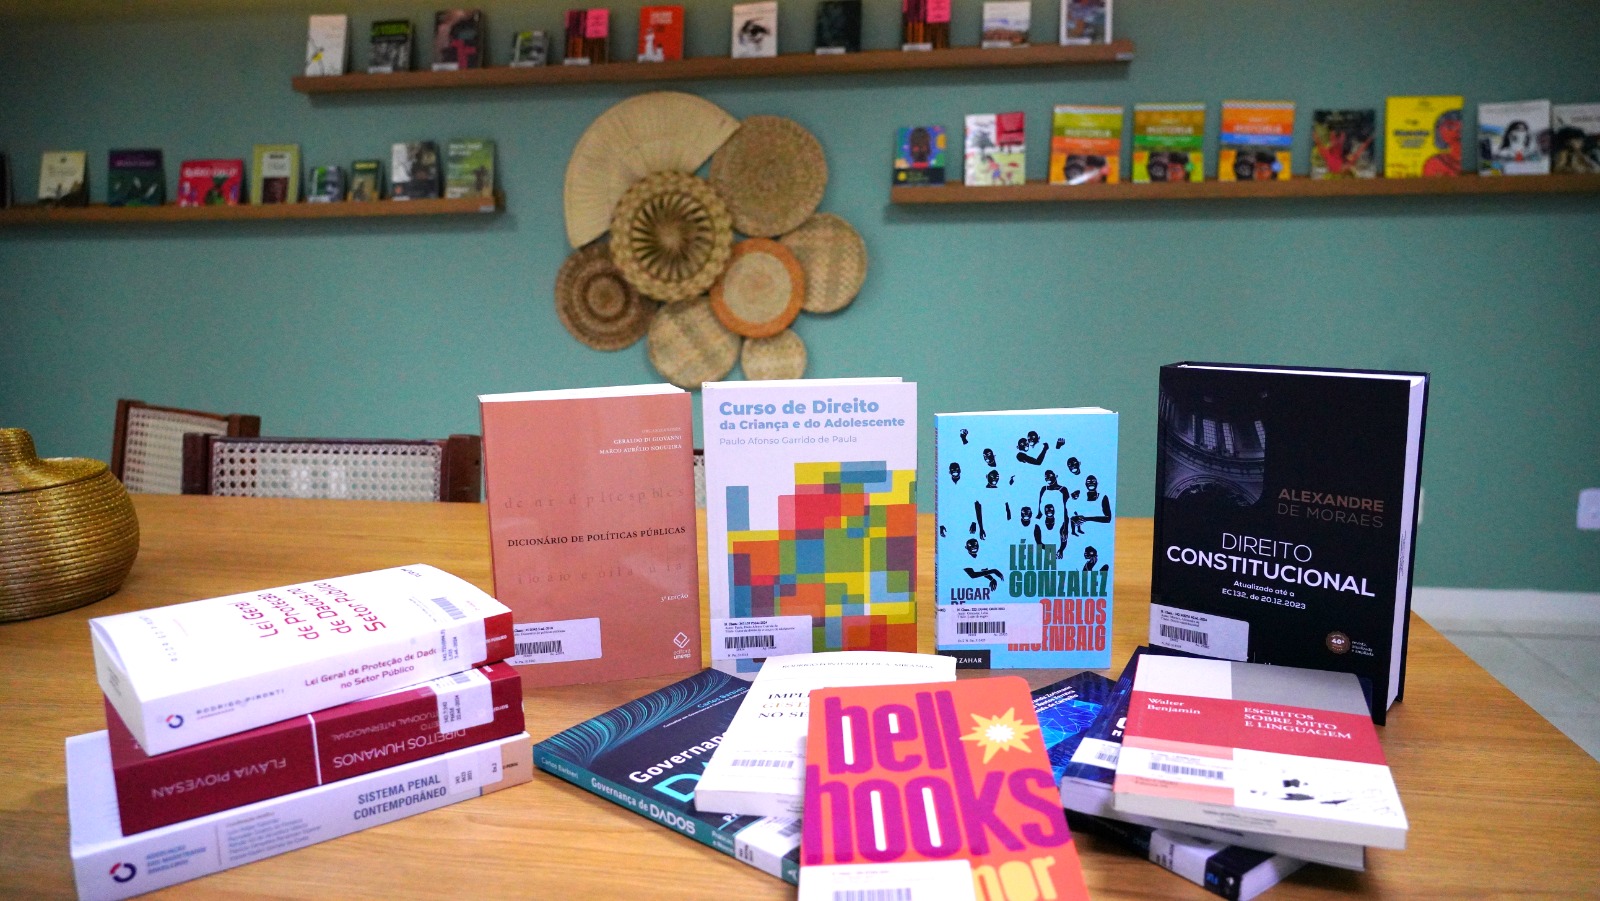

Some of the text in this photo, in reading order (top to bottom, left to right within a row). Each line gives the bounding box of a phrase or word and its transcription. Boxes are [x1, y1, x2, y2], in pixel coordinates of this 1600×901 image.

[719, 397, 880, 416] Curso de Direito
[719, 417, 905, 432] da Criança e do Adolescente
[623, 445, 651, 453] AURÉLIO
[719, 434, 858, 446] Paulo Afonso Garrido de Paula
[1278, 488, 1385, 512] ALEXANDRE
[1277, 503, 1384, 528] DE MORAES
[507, 526, 686, 547] DICIONÁRIO DE POLÍTICAS PÚBLICAS
[1221, 532, 1313, 563] DIREITO
[1009, 538, 1057, 571] LÉLIA
[1008, 570, 1109, 598] GONZALEZ
[1166, 545, 1376, 598] CONSTITUCIONAL
[950, 587, 990, 601] LUGAR
[1221, 588, 1233, 596] EC
[1249, 592, 1260, 601] de
[1260, 595, 1307, 610] 20.12.2023
[1233, 580, 1274, 594] Atualizado
[1274, 587, 1289, 596] até
[226, 600, 279, 638] Lei Geral
[257, 592, 320, 640] de Proteção
[298, 594, 339, 619] Dados
[348, 603, 387, 632] Setor
[1039, 598, 1107, 625] CARLOS
[329, 619, 352, 634] de
[304, 675, 319, 687] Lei
[320, 670, 347, 683] Geral
[348, 667, 360, 676] de
[361, 656, 403, 673] Proteção
[404, 653, 415, 662] de
[340, 664, 415, 689] no Setor Público
[196, 699, 242, 715] RODRIGO
[245, 688, 285, 703] PIRONTI
[696, 694, 719, 709] Carlos
[719, 685, 747, 699] Barbieri
[1146, 704, 1201, 715] Benjamin
[1147, 697, 1185, 707] Walter
[1243, 706, 1315, 720] ESCRITOS
[1243, 714, 1338, 731] SOBRE MITO
[330, 722, 397, 741] INTERNACIONAL
[824, 690, 961, 775] bell
[1256, 722, 1352, 740] LINGUAGEM
[332, 742, 405, 768] HUMANOS
[150, 757, 287, 799] FLÁVIA PIOVESAN
[357, 774, 441, 805] SISTEMA PENAL
[353, 786, 447, 820] CONTEMPORÂNEO
[591, 777, 637, 807] Governança
[638, 798, 649, 812] de
[649, 803, 696, 835] DADOS
[803, 764, 1073, 866] hooks
